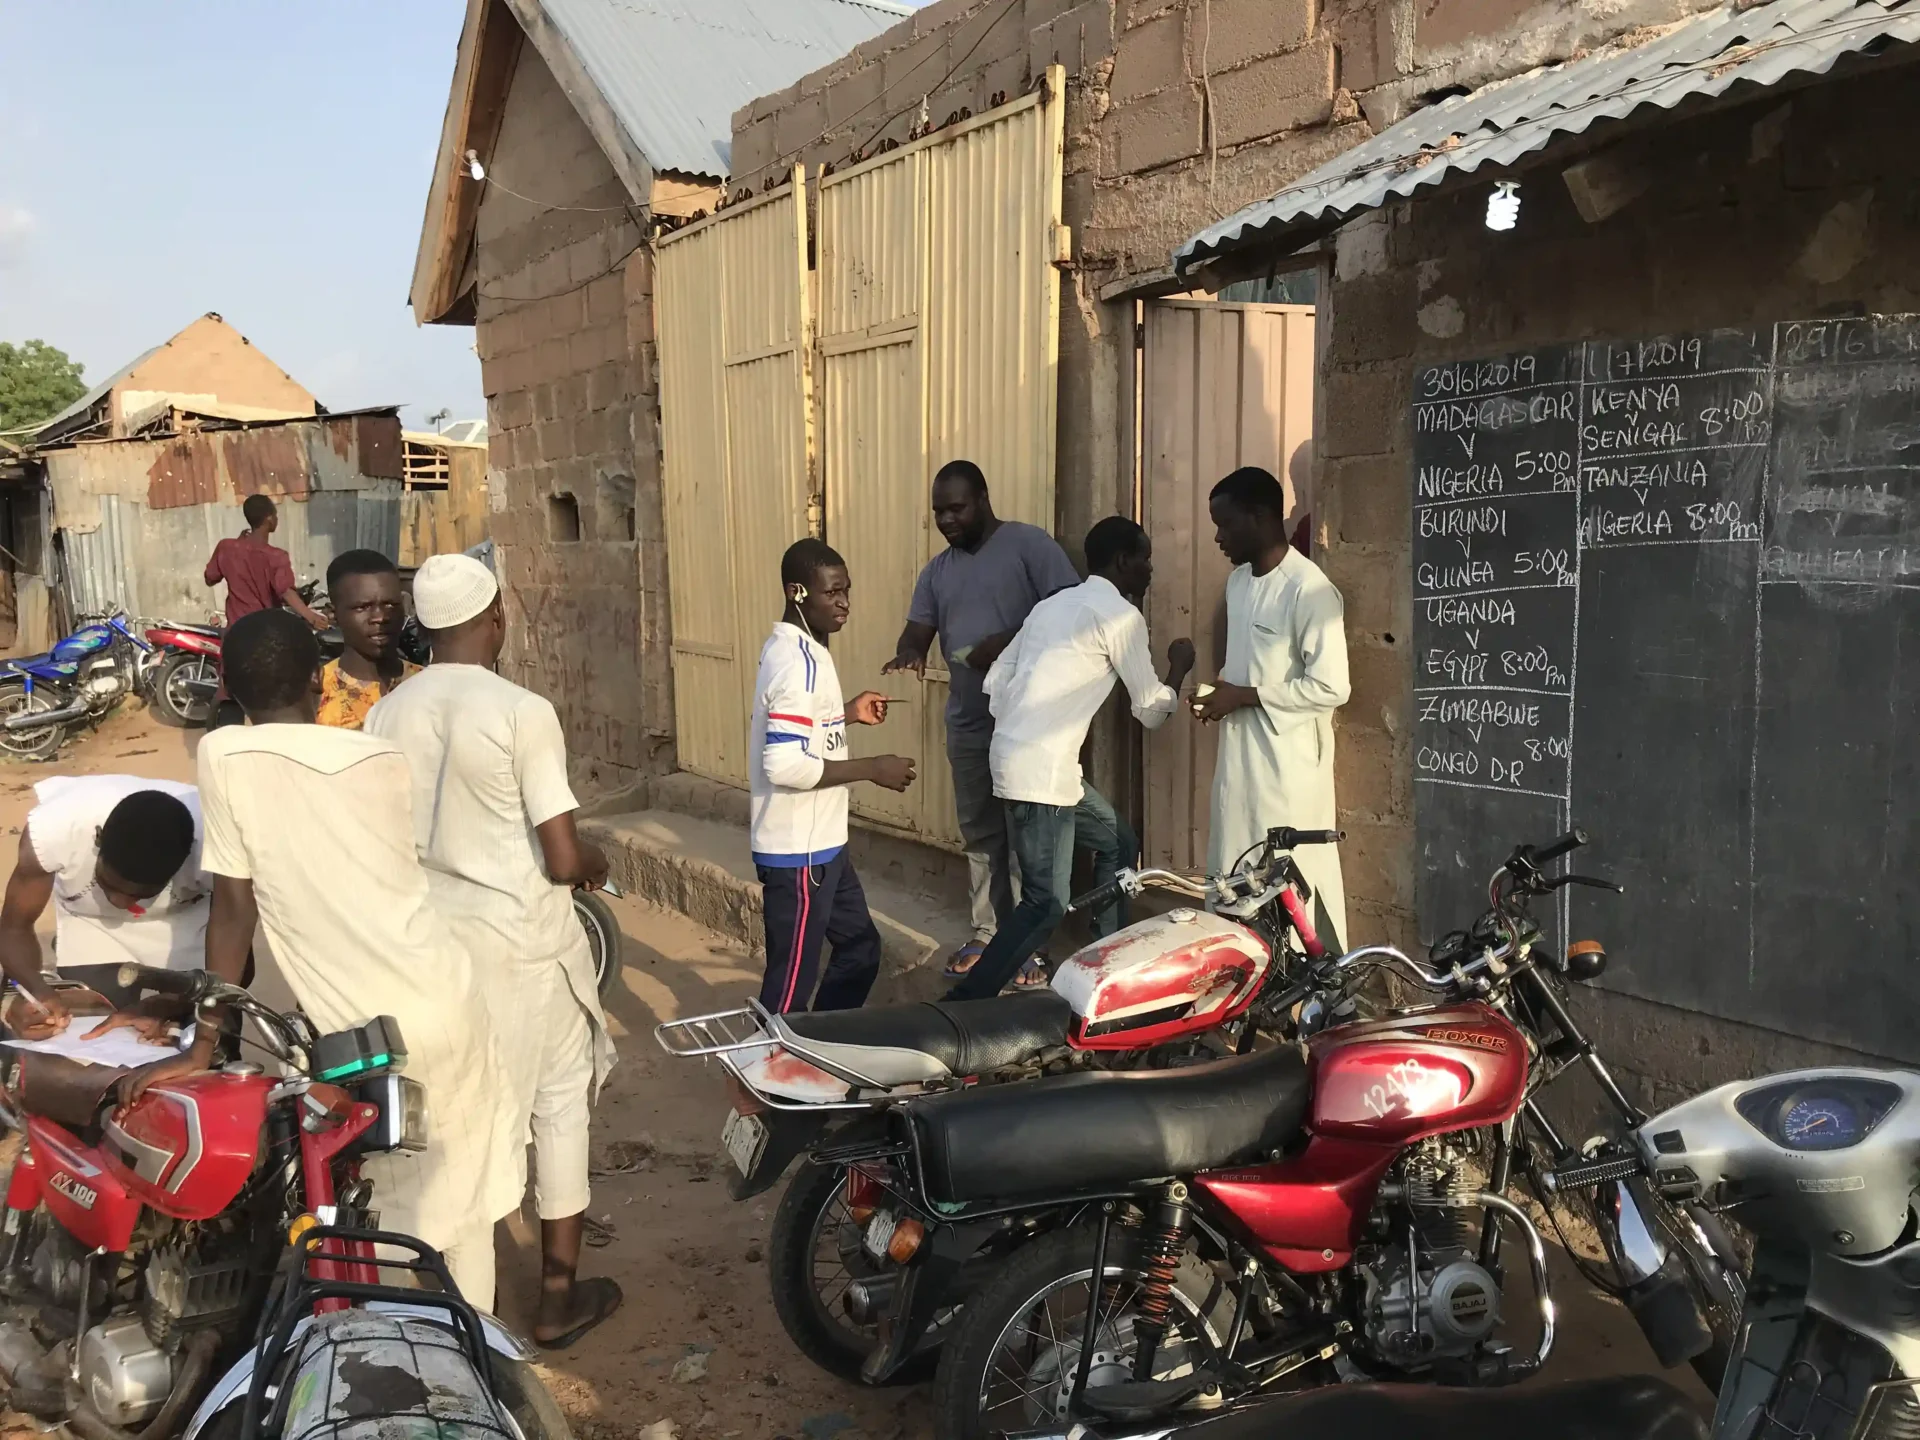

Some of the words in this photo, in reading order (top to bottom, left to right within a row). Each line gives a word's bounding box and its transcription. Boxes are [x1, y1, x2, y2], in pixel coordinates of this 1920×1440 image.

[1417, 391, 1575, 432] MADAGASCAR
[1592, 383, 1680, 416] KENYA
[1583, 421, 1688, 451] SENIGAL
[1700, 391, 1764, 435] 8:00
[1418, 463, 1503, 498] NIGERIA
[1515, 450, 1570, 481] 5:00
[1583, 459, 1708, 492] TANZANIA
[1420, 506, 1507, 538] BURUNDI
[1685, 501, 1741, 532] 8:00
[1417, 561, 1494, 590] GUINEA
[1513, 548, 1568, 575] 5:00
[1426, 598, 1516, 627] UGANDA
[1426, 649, 1489, 685] EGYPT
[1500, 645, 1548, 676] 8:00
[1418, 695, 1540, 727] ZIMBABWE
[1417, 746, 1479, 774] CONGO
[1523, 736, 1569, 762] 8:00
[1426, 1028, 1508, 1050] BOXER
[1452, 1298, 1487, 1311] BAJAJ
